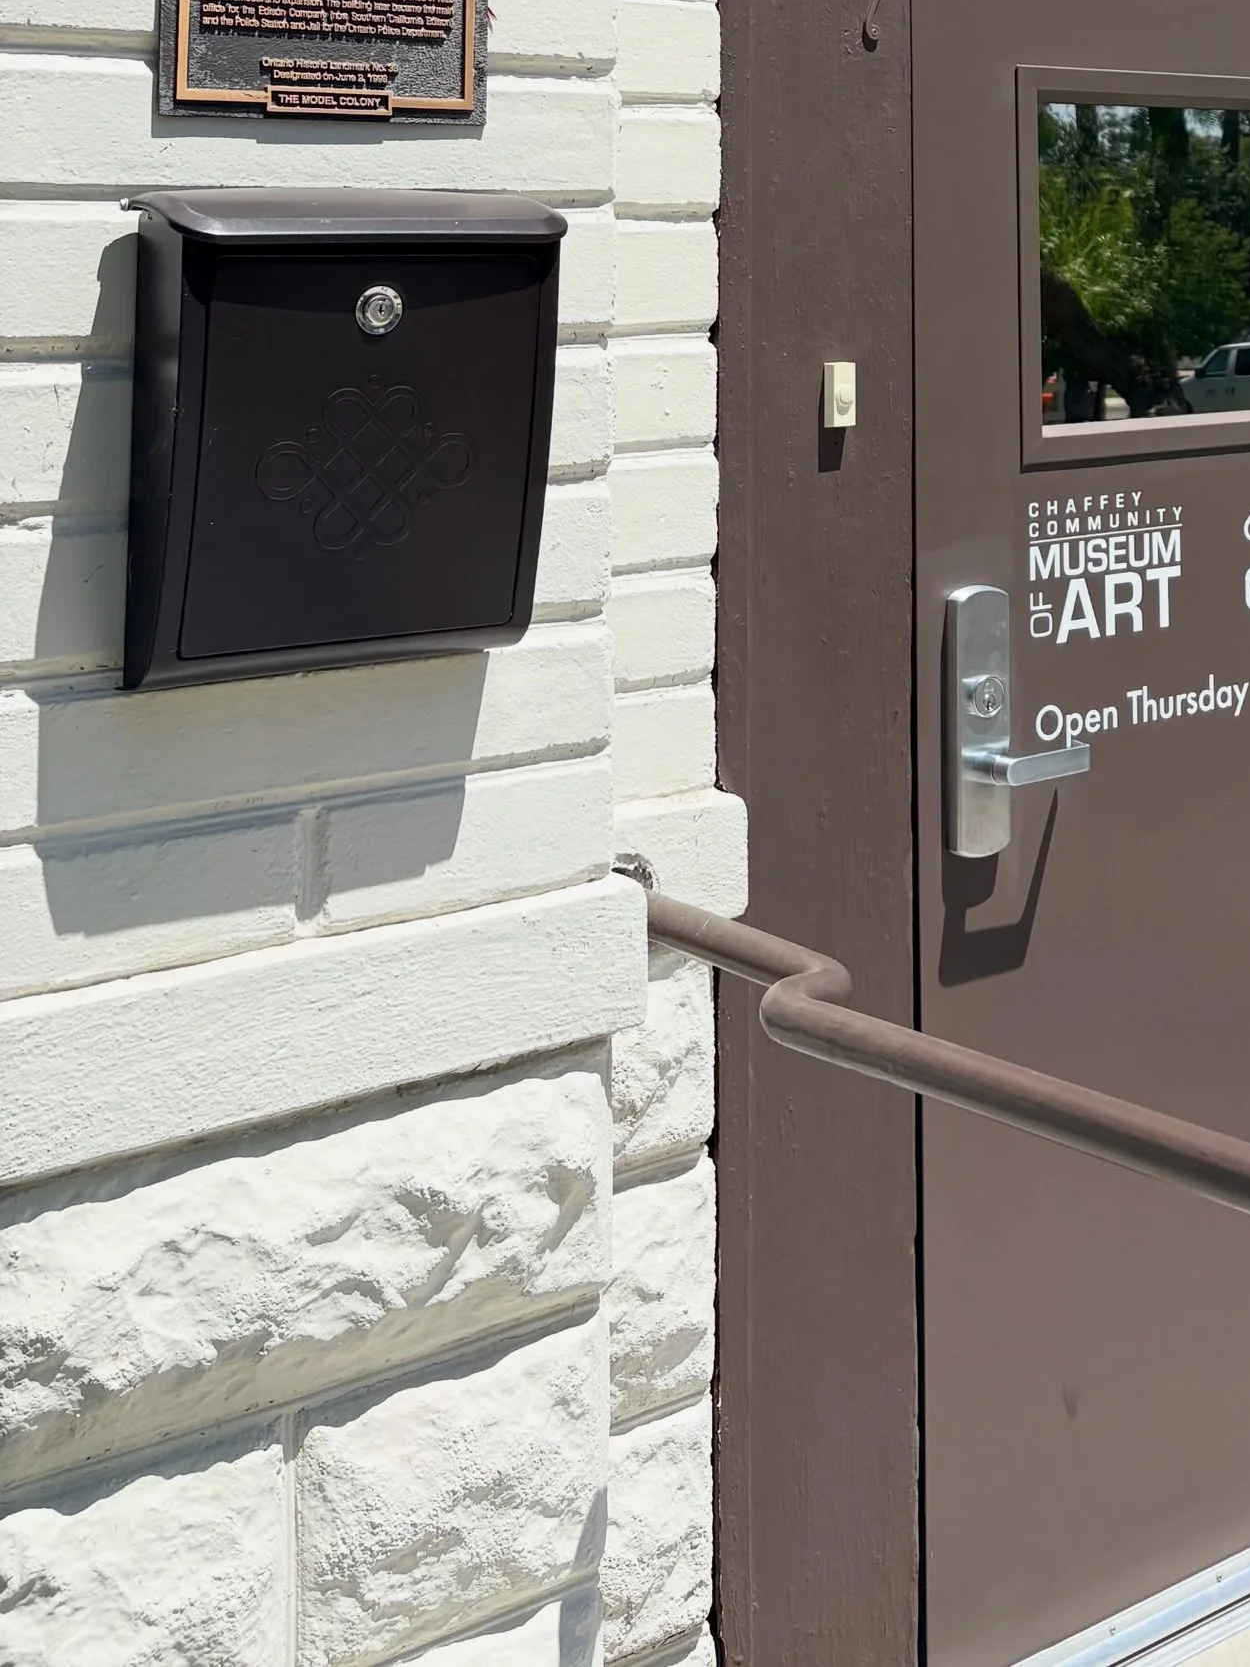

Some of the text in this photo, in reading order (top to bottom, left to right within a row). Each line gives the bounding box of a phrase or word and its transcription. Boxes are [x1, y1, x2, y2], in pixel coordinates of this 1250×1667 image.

[203, 3, 225, 13] office
[242, 5, 255, 15] the
[258, 6, 286, 16] Edison
[289, 7, 328, 20] Company
[351, 12, 386, 23] Southern
[388, 14, 424, 25] California
[342, 0, 373, 11] building
[392, 2, 422, 13] became
[203, 15, 218, 25] and
[220, 15, 233, 26] the
[235, 17, 259, 27] Police
[261, 18, 289, 29] Station
[290, 20, 305, 30] and
[322, 22, 333, 31] for
[334, 22, 347, 32] the
[347, 23, 376, 34] Ontario
[377, 25, 401, 35] Police
[262, 57, 295, 68] Ontario
[296, 58, 328, 69] Historic
[330, 60, 370, 71] Landmark
[273, 69, 321, 80] Designated
[323, 72, 334, 81] on
[334, 72, 356, 81] June
[278, 94, 381, 107] THE MODEL COLONY
[1028, 491, 1142, 518] CHAFFEY
[1028, 506, 1183, 538] COMMUNITY
[1029, 529, 1181, 581] MUSEUM
[1030, 565, 1181, 644] OF ART
[1036, 700, 1118, 747] Open
[1127, 674, 1249, 725] Thursday
